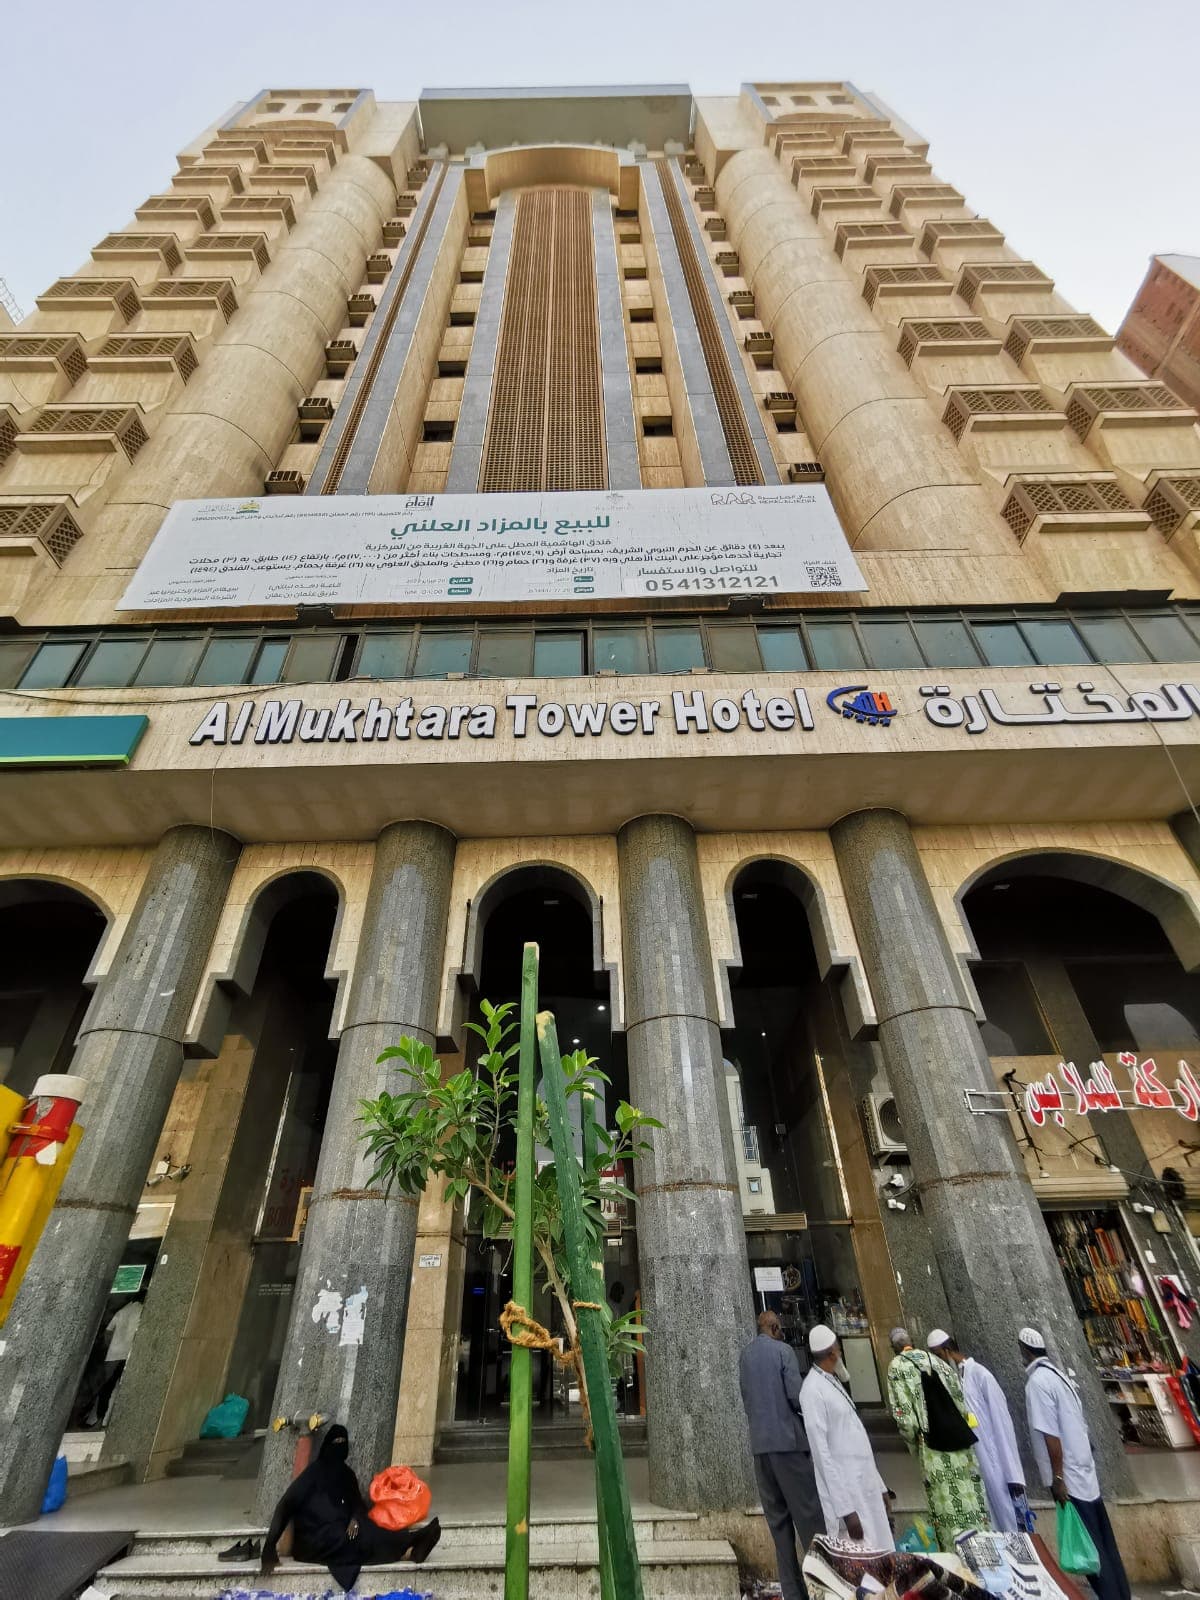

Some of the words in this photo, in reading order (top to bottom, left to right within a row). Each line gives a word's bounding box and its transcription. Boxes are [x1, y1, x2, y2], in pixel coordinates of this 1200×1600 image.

[390, 519, 471, 540] العلني
[477, 517, 548, 535] بالمزاد
[554, 515, 610, 535] للبيع
[365, 543, 406, 552] المركزية
[407, 543, 422, 551] من
[424, 542, 456, 551] الغربية
[457, 542, 484, 551] الجهة
[485, 542, 507, 550] على
[507, 541, 539, 550] المطل
[540, 540, 585, 549] الهاشمية
[586, 540, 612, 548] فندق
[720, 543, 746, 552] دقائق
[547, 547, 566, 556] أرض
[568, 548, 604, 556] بمساحة
[677, 545, 701, 553] الحرم
[300, 553, 330, 562] بارتفاع
[399, 550, 420, 559] أكثر
[422, 551, 439, 559] بناء
[654, 554, 678, 563] البنك
[753, 551, 782, 560] تجارية
[410, 560, 449, 568] والملحق
[556, 556, 578, 565] غرفة
[218, 564, 250, 574] الفندق
[250, 563, 291, 571] يستوعب
[325, 562, 347, 570] غرفة
[376, 561, 410, 570] العلوي
[709, 564, 758, 574] للتواصل
[637, 566, 706, 577] والاستفسار
[645, 575, 778, 592] 0541312121
[918, 682, 1200, 735] المختارة
[188, 700, 255, 746] Al
[254, 696, 497, 745] Mukhtara
[506, 694, 660, 738] Tower
[672, 688, 815, 735] Hotel
[1025, 1061, 1124, 1127] الملابس
